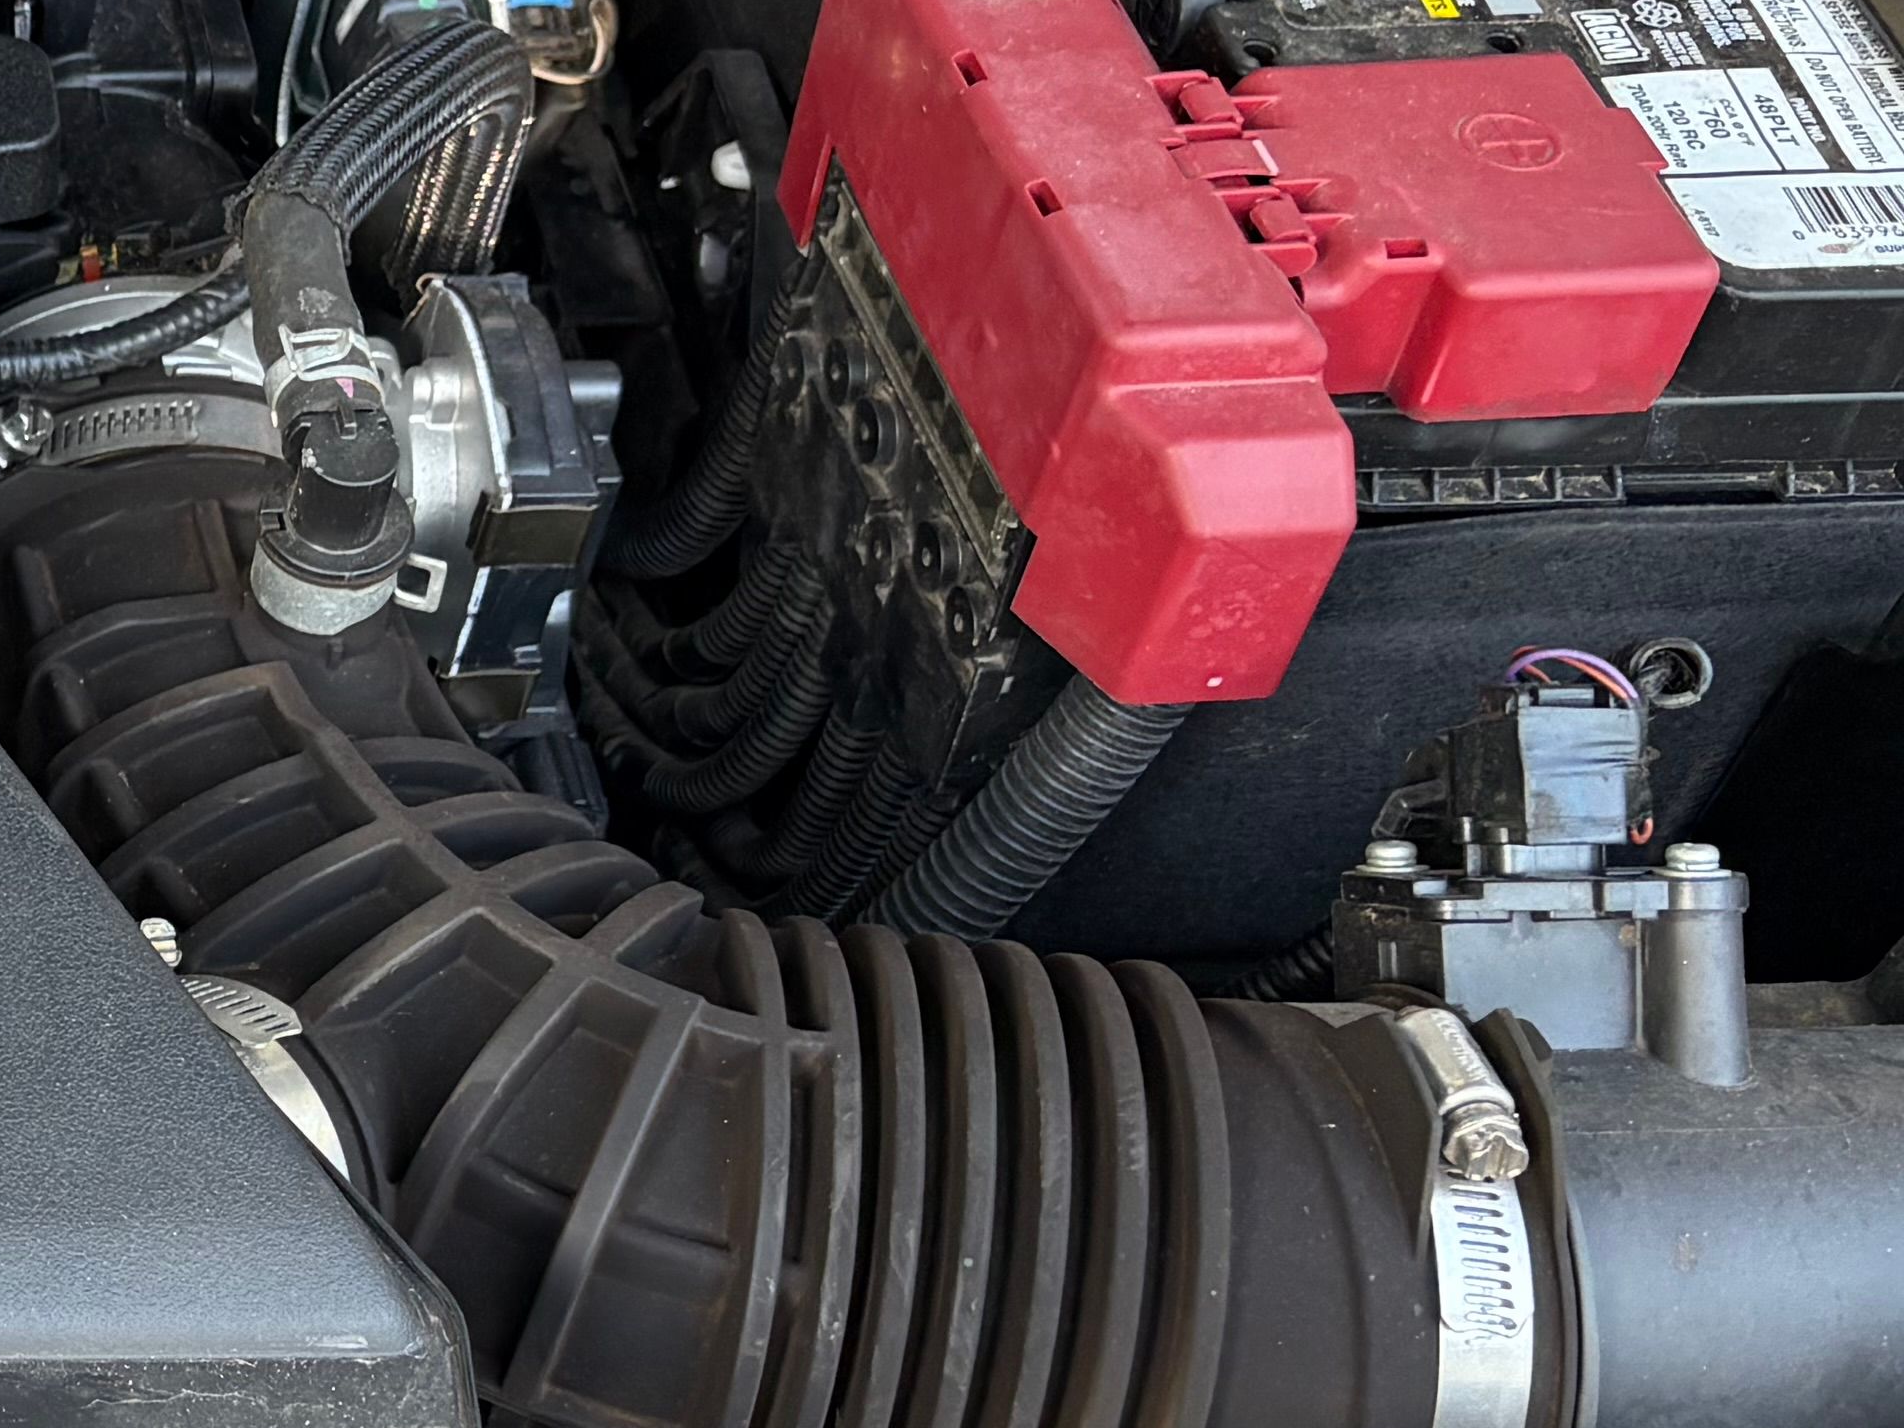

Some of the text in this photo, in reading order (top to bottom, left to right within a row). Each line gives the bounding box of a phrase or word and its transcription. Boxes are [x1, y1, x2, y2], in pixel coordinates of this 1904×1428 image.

[1579, 13, 1639, 61] AGM
[1755, 94, 1800, 147] 48PLT
[1789, 96, 1817, 125] PART
[1814, 73, 1842, 93] NOT
[1829, 95, 1858, 122] OPEN
[1625, 83, 1659, 112] 70Ah
[1660, 143, 1692, 168] Rate
[1659, 100, 1708, 150] 120 RC
[1693, 107, 1734, 139] 760
